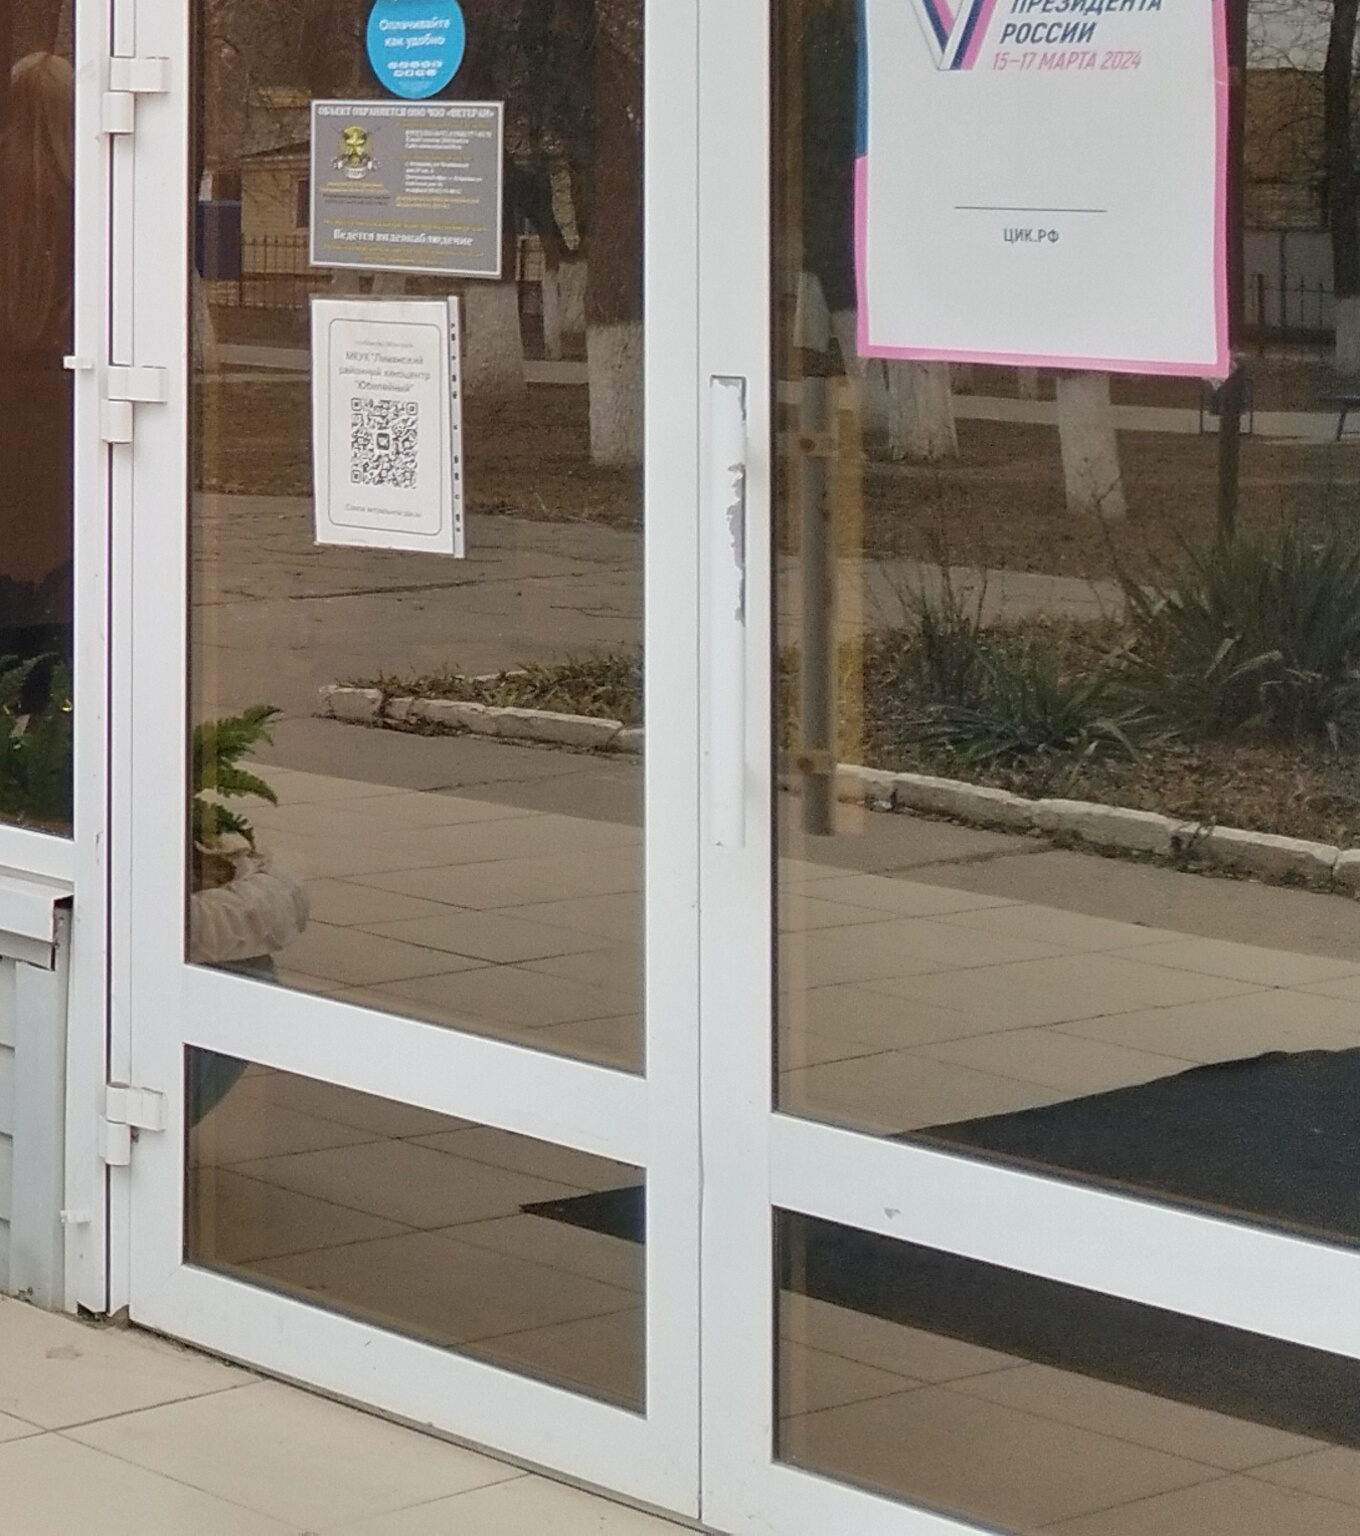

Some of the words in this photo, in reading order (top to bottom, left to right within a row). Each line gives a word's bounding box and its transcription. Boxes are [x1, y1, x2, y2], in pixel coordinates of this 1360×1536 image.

[1000, 21, 1097, 44] РОССИИ
[1038, 51, 1097, 70] МАРТА
[1100, 50, 1142, 70] 2024
[1004, 228, 1059, 244] ЦИК.РФ
